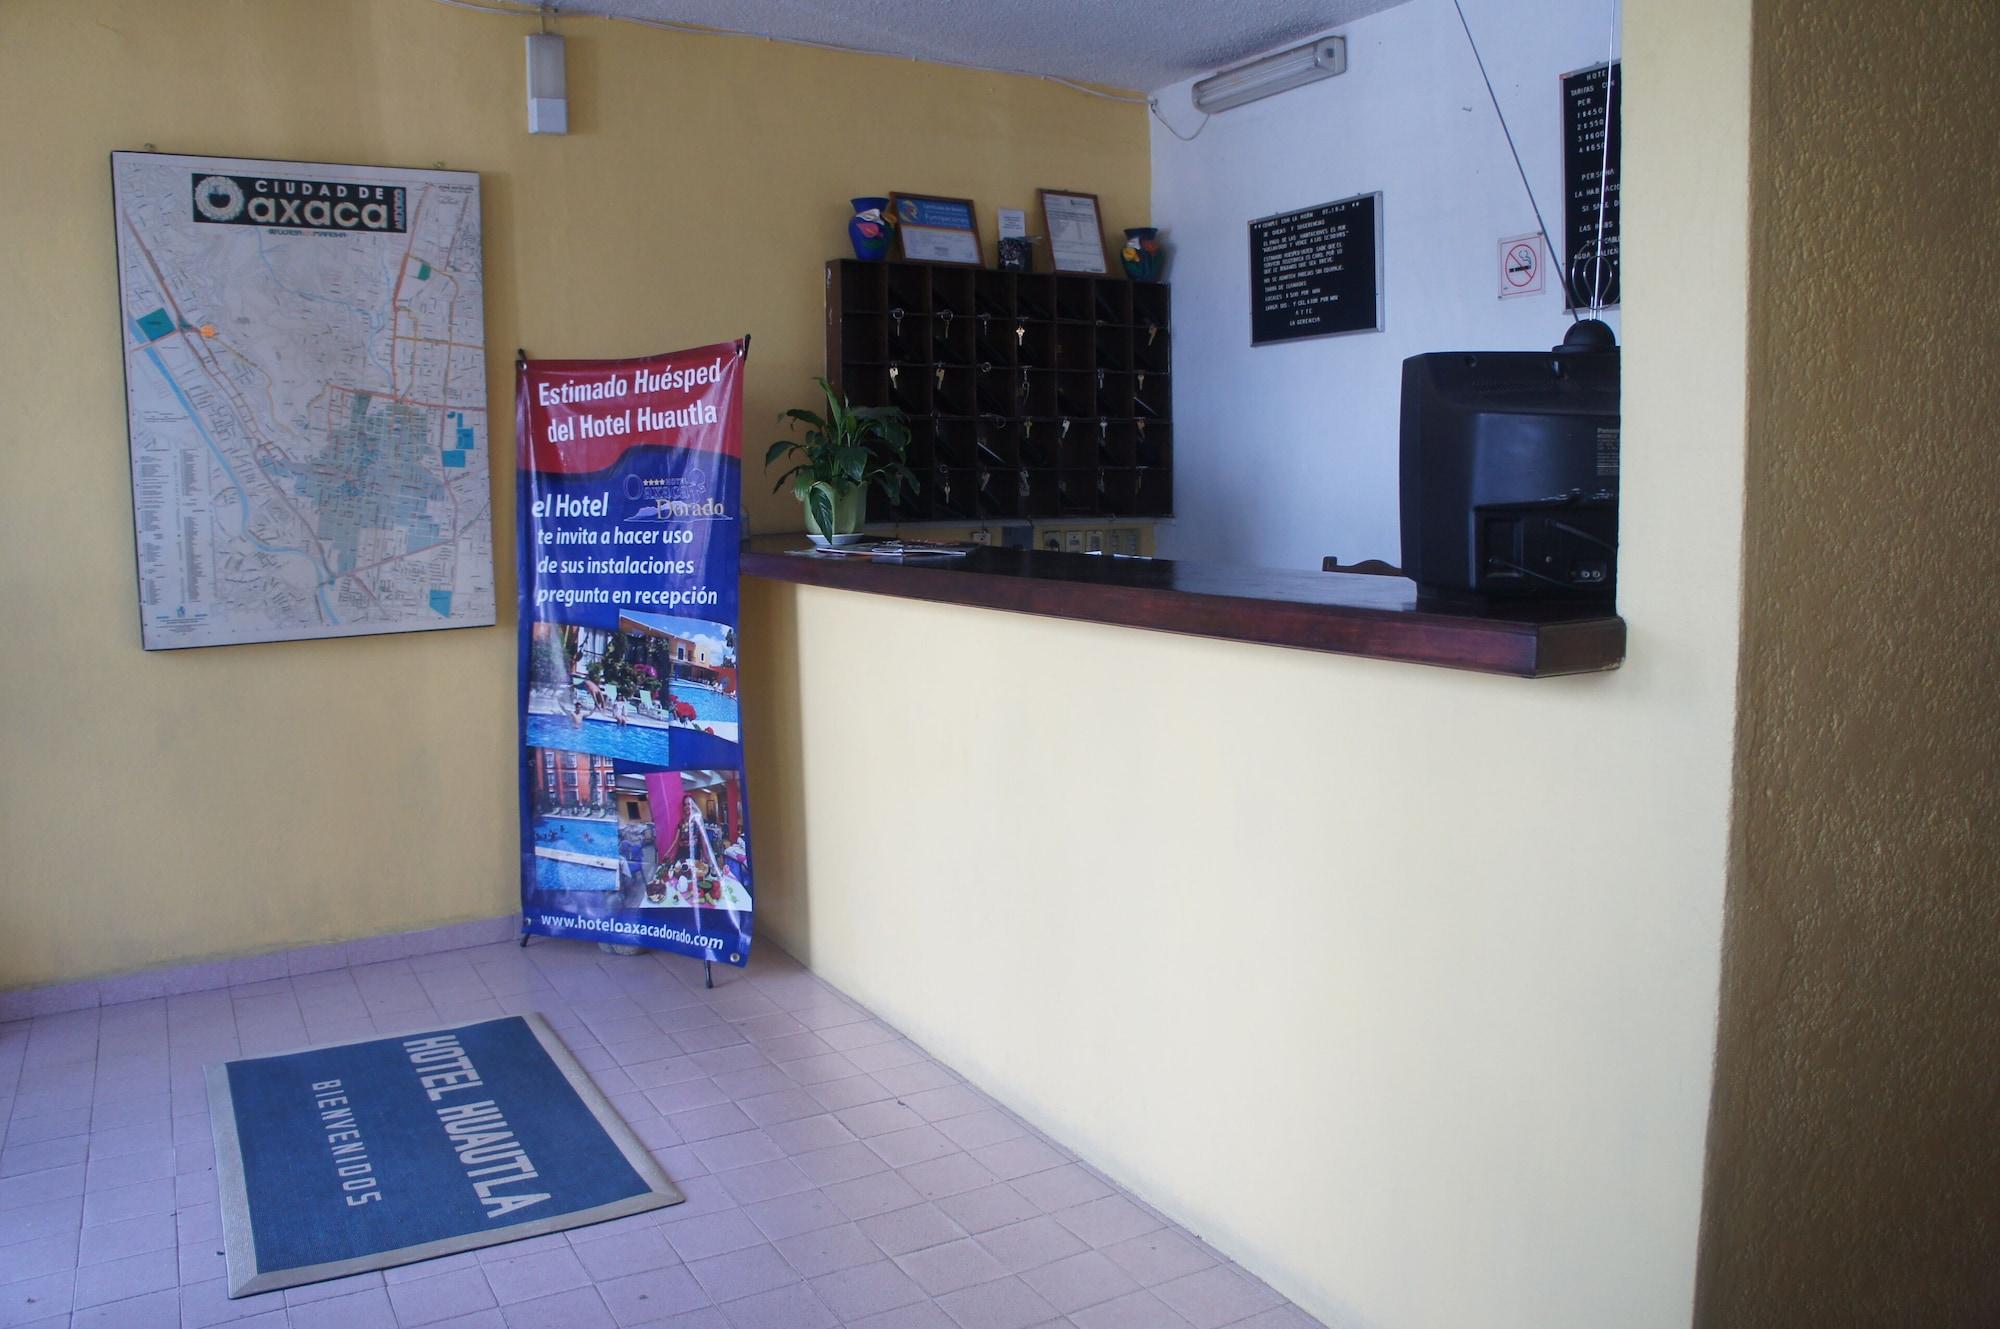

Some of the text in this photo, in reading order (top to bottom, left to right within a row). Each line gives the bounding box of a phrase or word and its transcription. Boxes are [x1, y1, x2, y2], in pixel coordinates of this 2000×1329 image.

[1587, 70, 1609, 80] HOTE
[255, 180, 384, 200] CIUDAD DE
[1579, 224, 1591, 232] LAS
[538, 358, 721, 406] Estimado Huésped
[548, 400, 718, 443] del Hotel Huautla
[532, 492, 609, 518] el Hotel
[656, 498, 724, 520] Dorado
[538, 526, 694, 545] te invita a hacer uso
[538, 556, 695, 574] de sus instalaciones
[536, 586, 718, 608] pregunta en recepción
[541, 914, 724, 950] www.hoteloaxacadorado.com
[402, 1034, 552, 1219] HOTEL HUAUTLA
[312, 1079, 382, 1207] BIENVENIDOS
